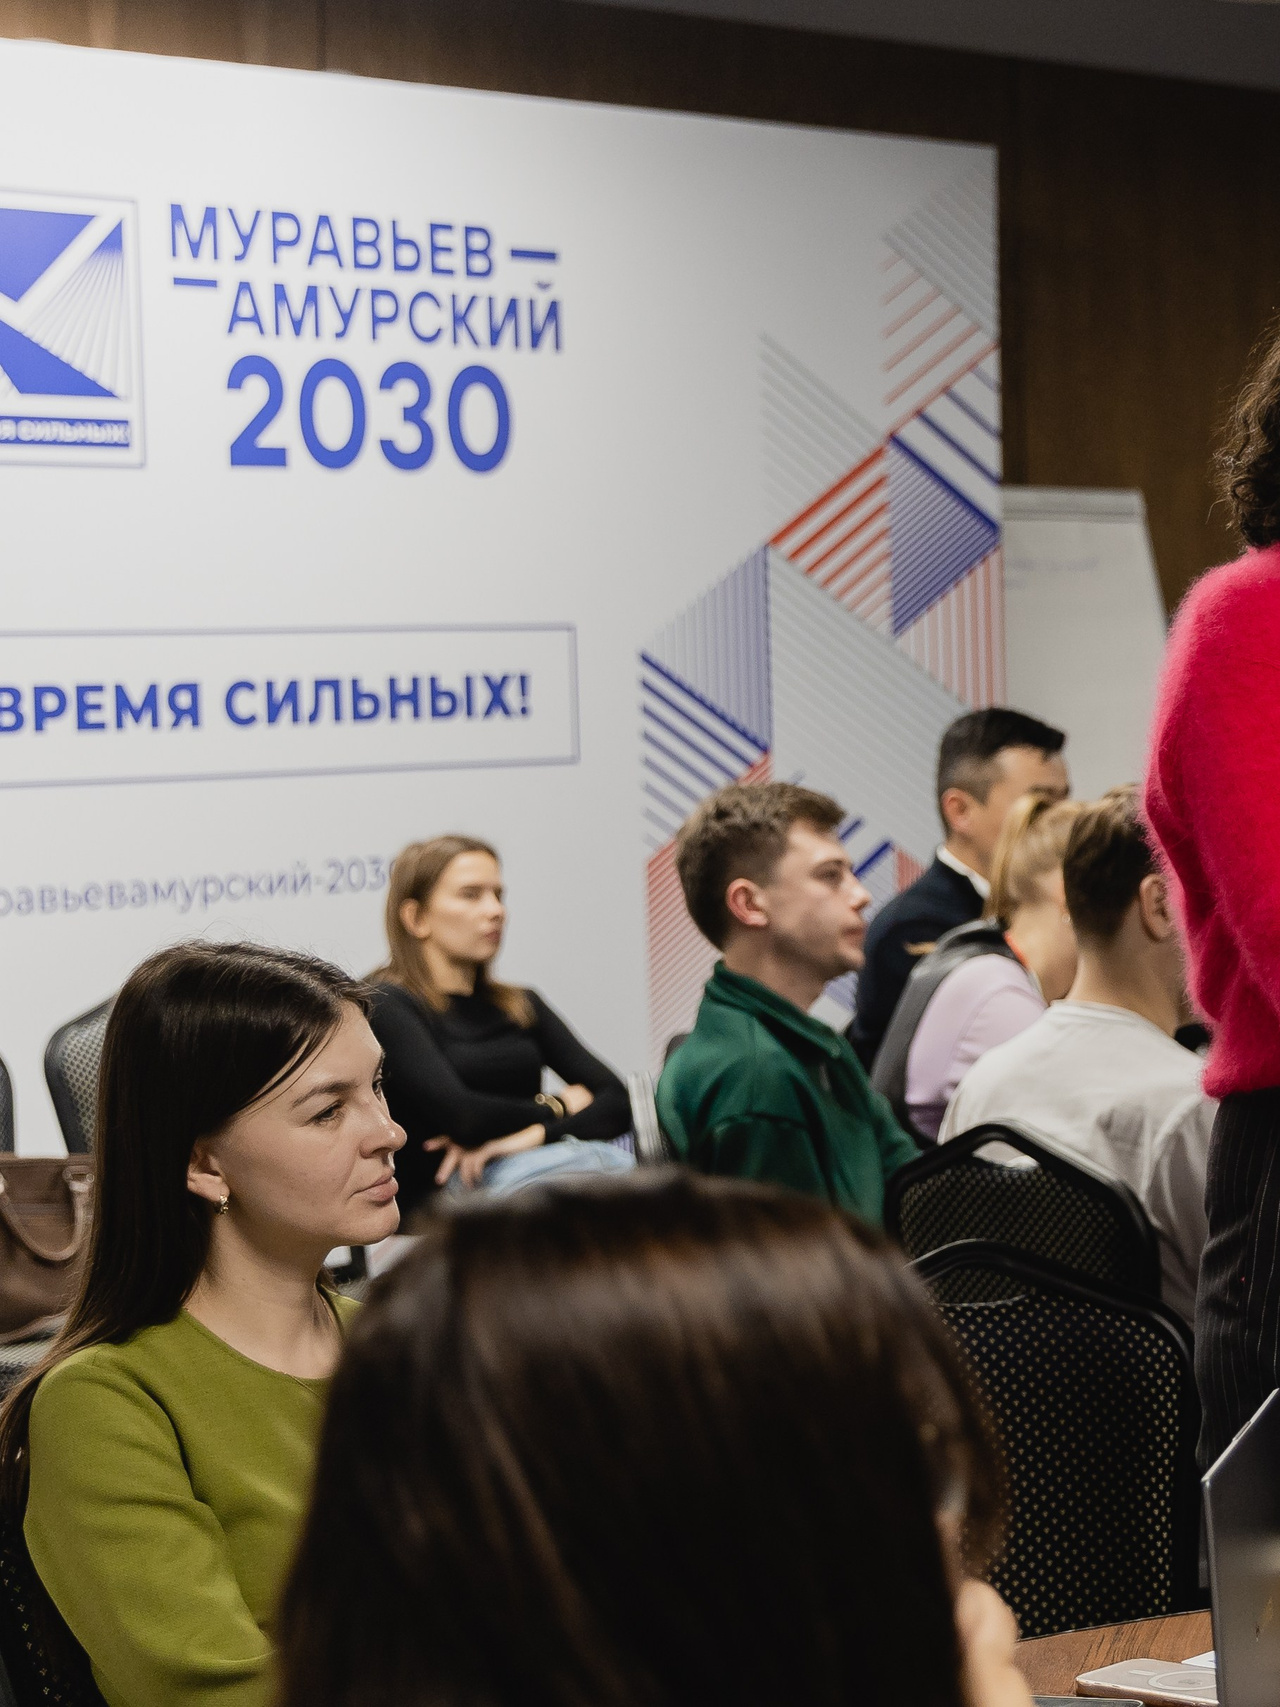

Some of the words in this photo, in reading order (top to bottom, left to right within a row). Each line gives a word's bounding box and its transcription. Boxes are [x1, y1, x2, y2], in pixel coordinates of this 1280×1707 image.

[226, 354, 512, 472] 2030
[0, 683, 200, 733] ВРЕМЯ
[225, 674, 531, 725] СИЛЬНЫХ!
[0, 854, 397, 916] авьевамурский-203
